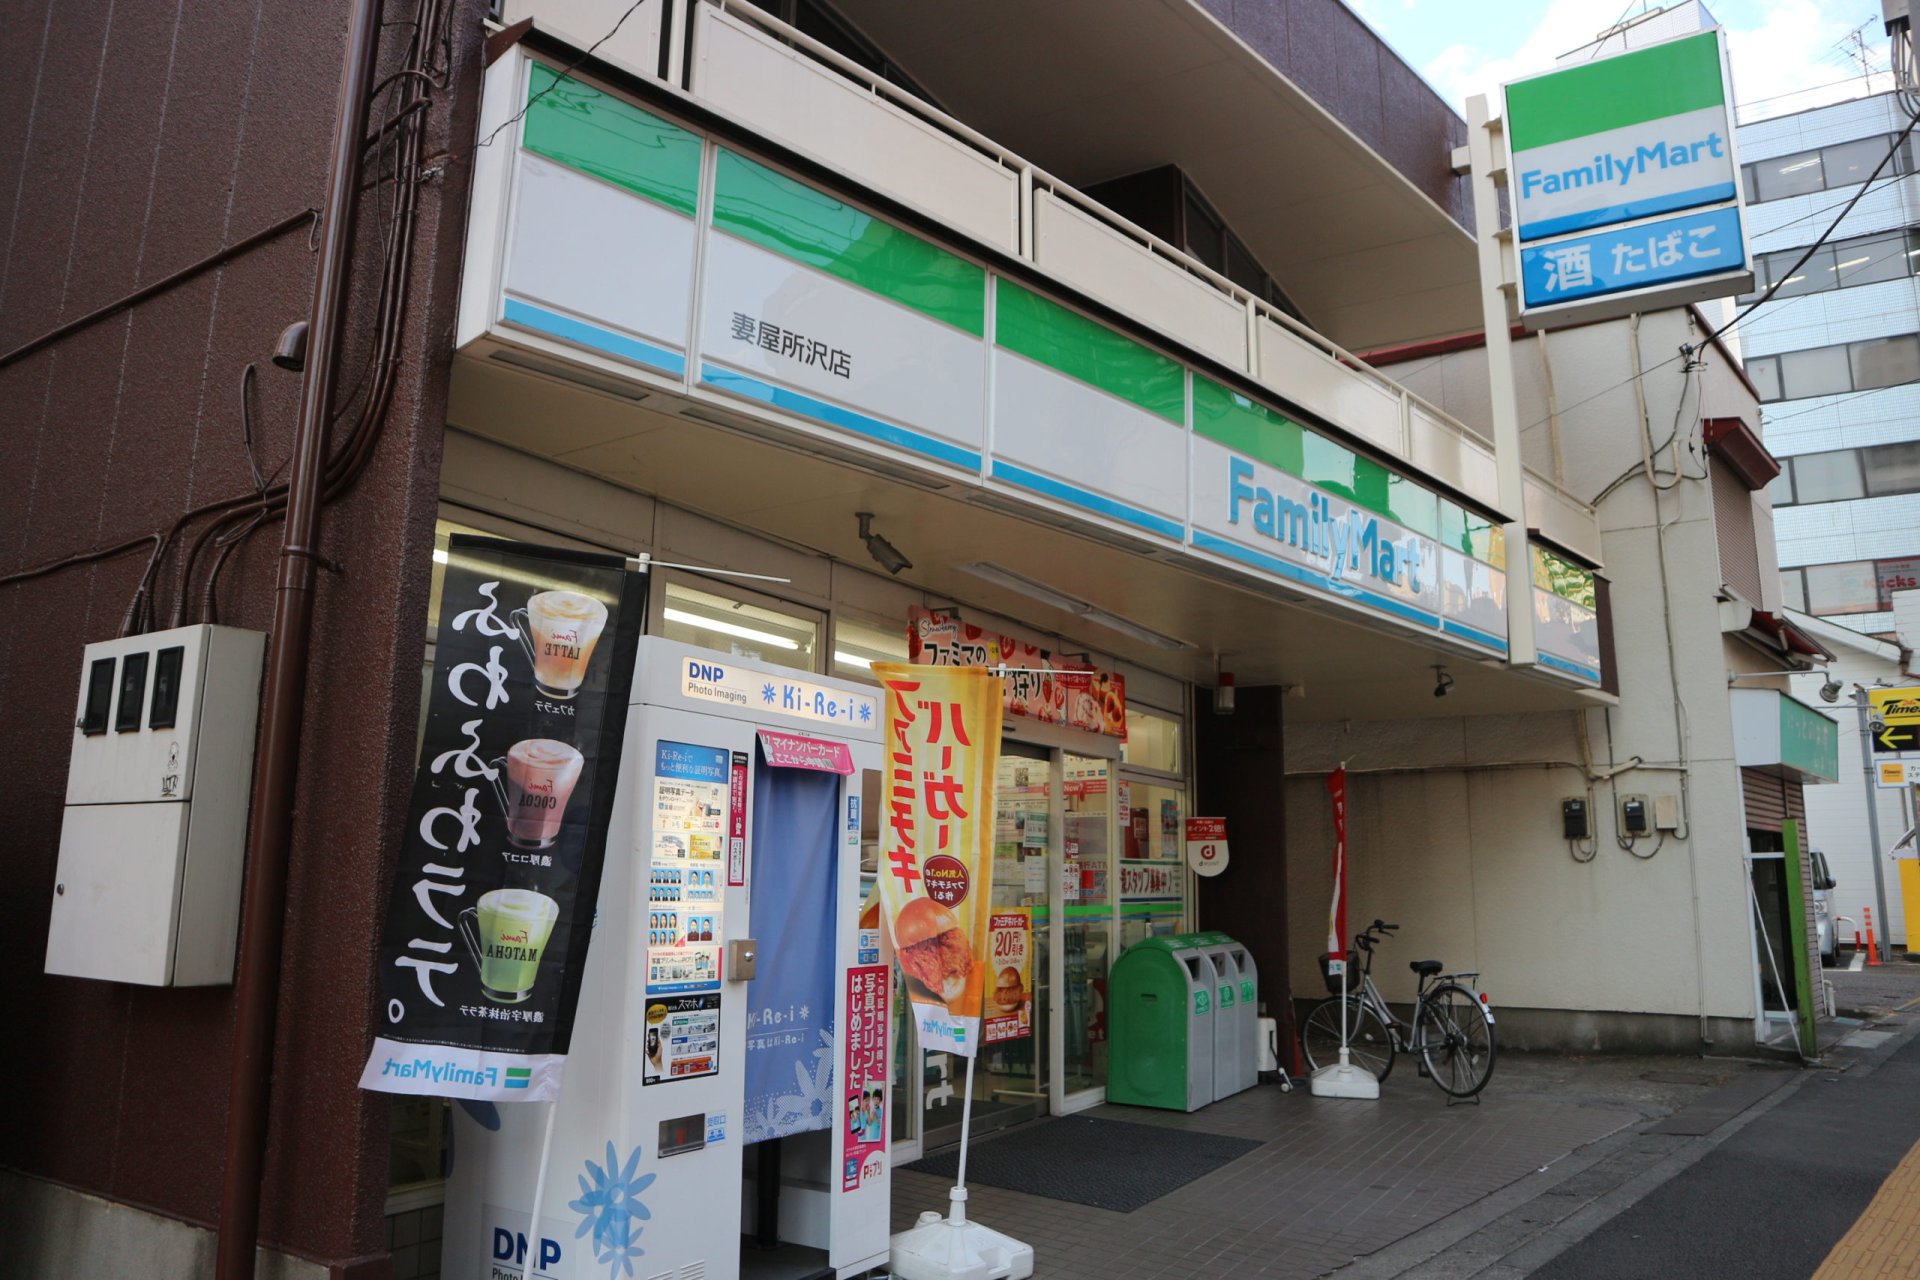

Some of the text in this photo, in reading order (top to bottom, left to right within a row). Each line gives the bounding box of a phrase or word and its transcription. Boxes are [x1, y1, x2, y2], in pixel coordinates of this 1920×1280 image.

[1521, 132, 1723, 200] FamilyMart
[1543, 224, 1722, 293] 酒 たばこ
[1227, 455, 1421, 594] FamilyMart
[688, 661, 724, 683] DNP
[687, 682, 747, 704] Photo Imaging
[782, 684, 854, 722] Ki-Re-i
[772, 736, 841, 758] マイナンバーカード
[995, 931, 1012, 957] 20
[678, 997, 700, 1010] スマホ
[850, 974, 864, 1091] はじめました
[863, 971, 877, 1090] 写真プリント
